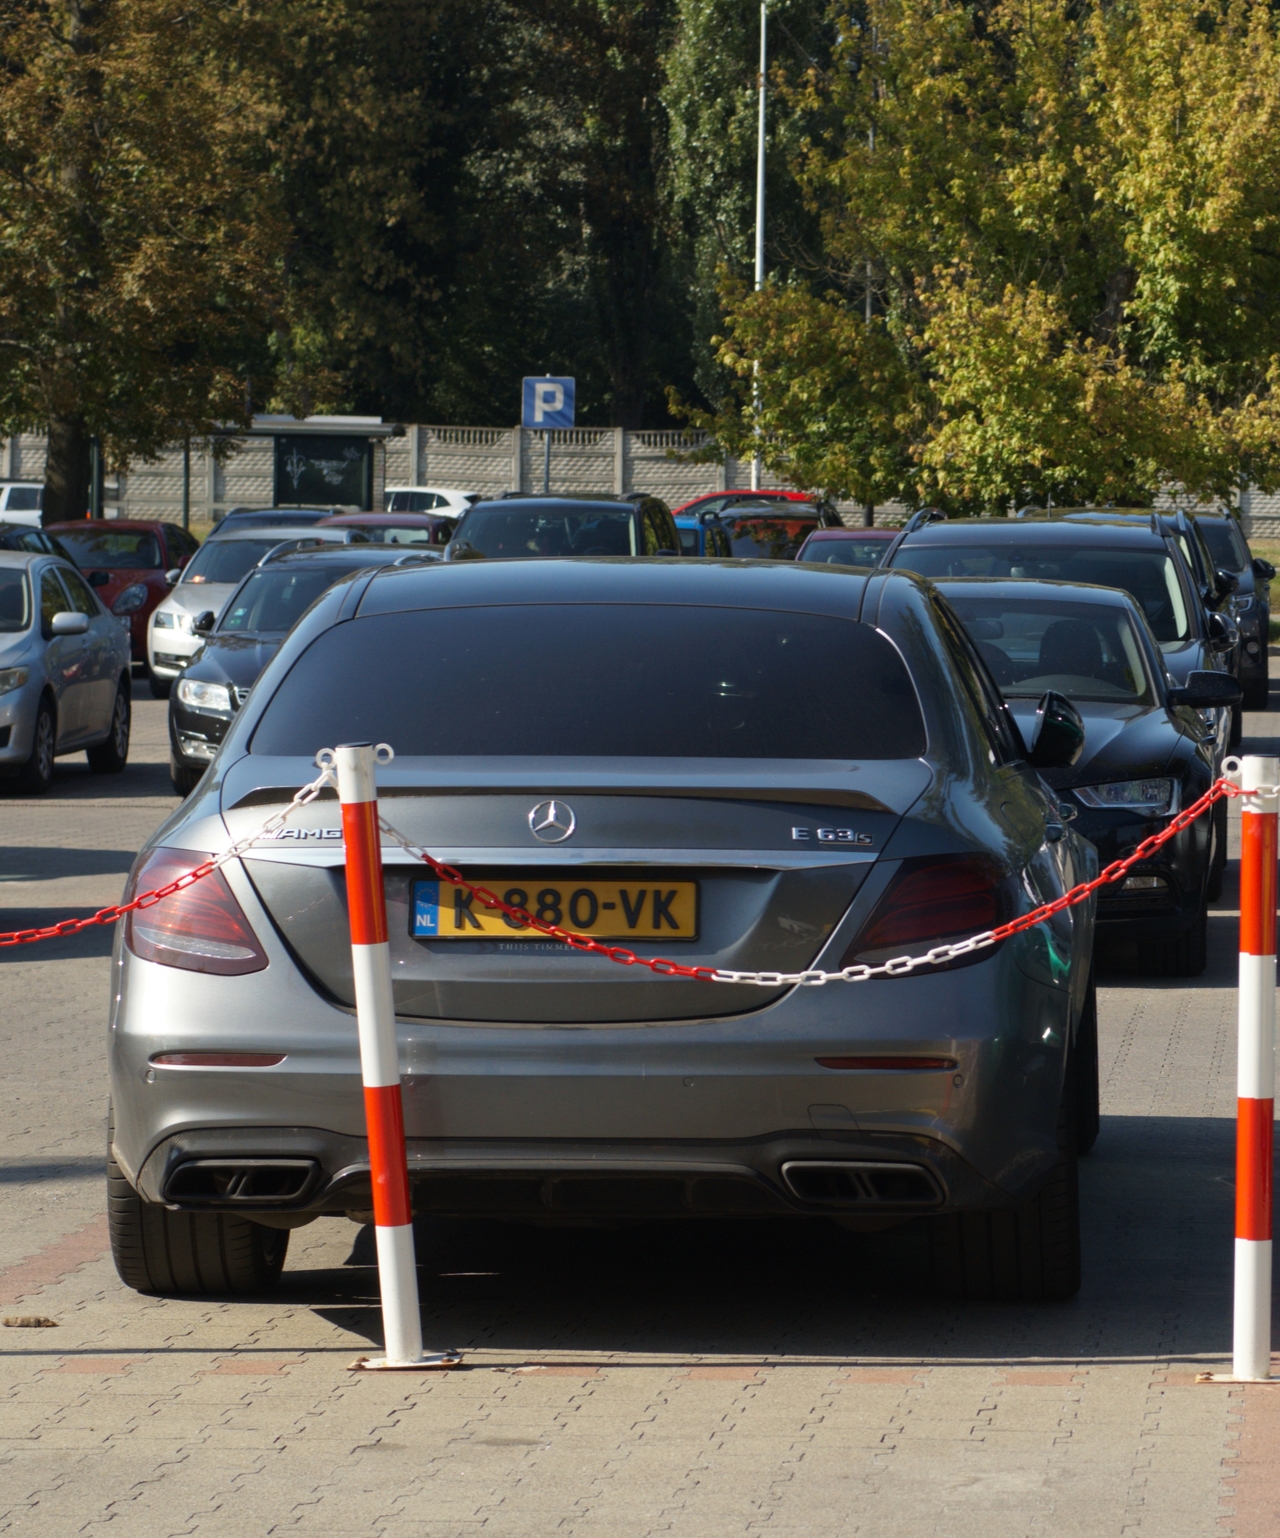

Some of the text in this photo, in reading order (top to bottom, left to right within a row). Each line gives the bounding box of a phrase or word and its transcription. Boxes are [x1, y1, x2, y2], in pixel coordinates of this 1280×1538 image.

[534, 383, 564, 422] P
[280, 828, 343, 840] AMG
[791, 827, 810, 840] E
[453, 888, 680, 930] K-880-VK
[416, 914, 435, 927] NL
